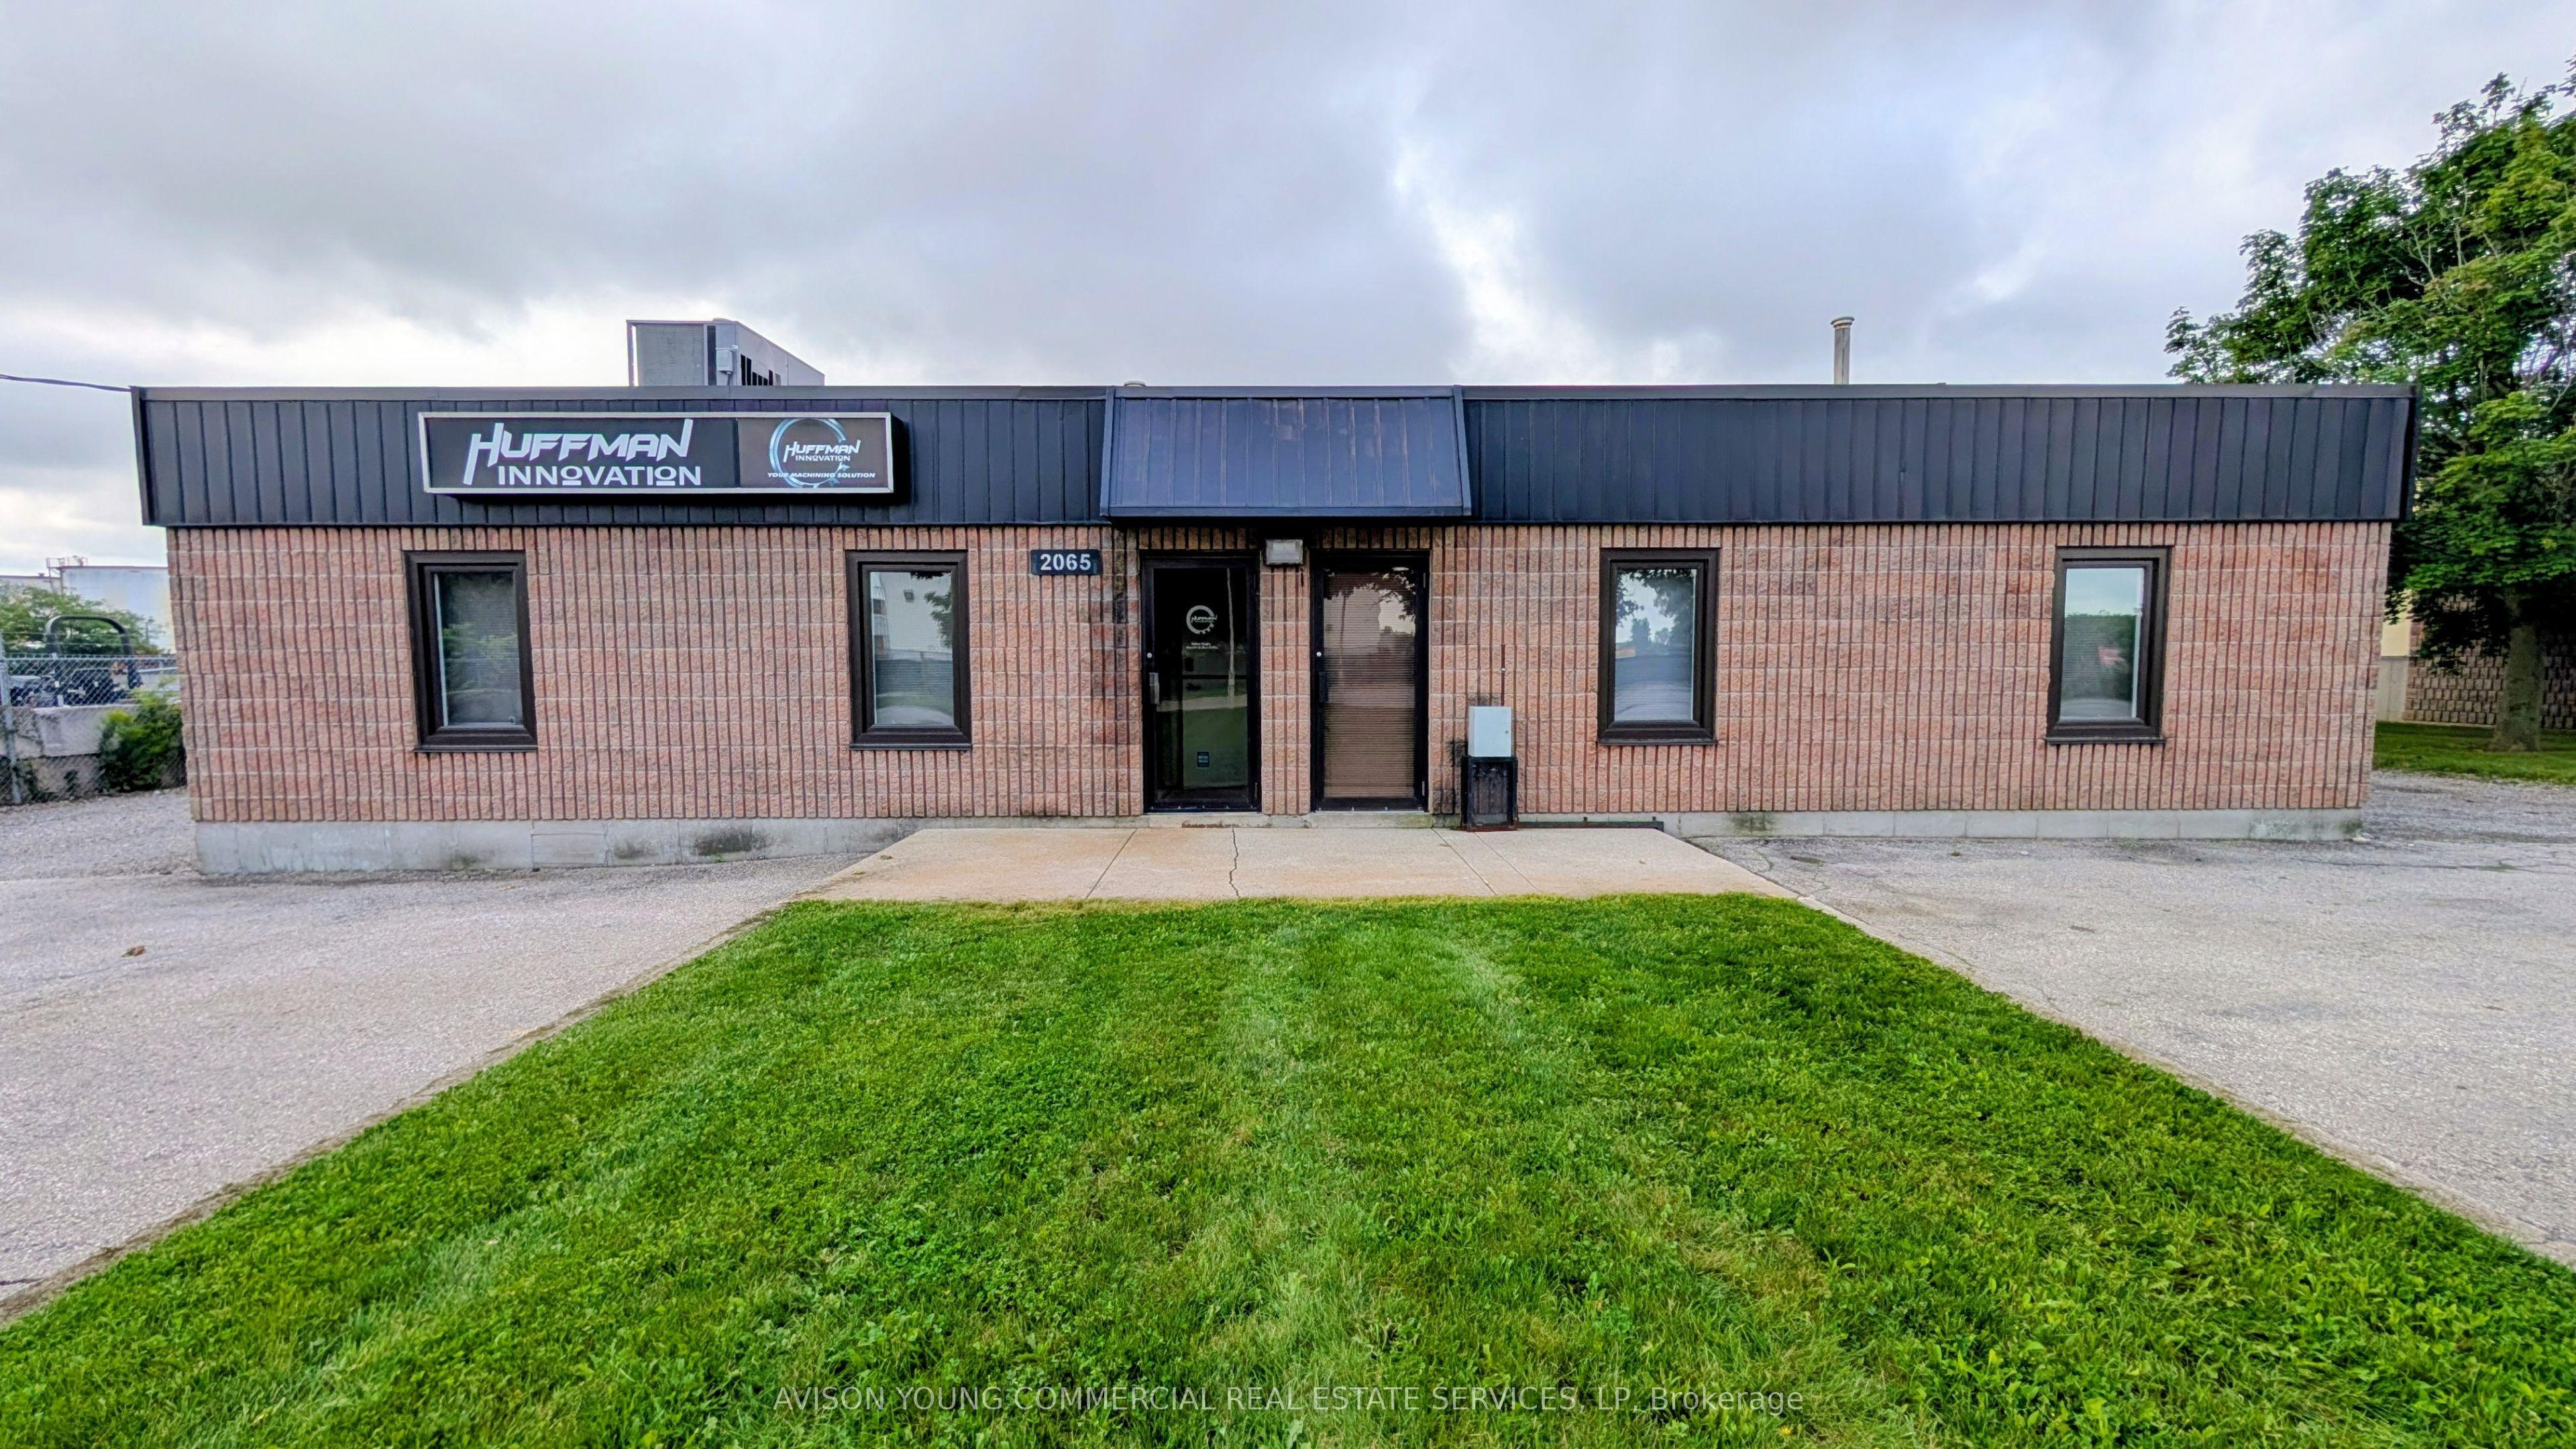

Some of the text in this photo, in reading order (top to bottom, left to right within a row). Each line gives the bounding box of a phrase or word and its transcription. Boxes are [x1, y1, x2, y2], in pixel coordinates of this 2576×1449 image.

[463, 419, 694, 486] HUFFMAN
[782, 439, 861, 463] HUFFMAN
[498, 466, 701, 486] INNOVATION
[1040, 553, 1091, 571] 2065
